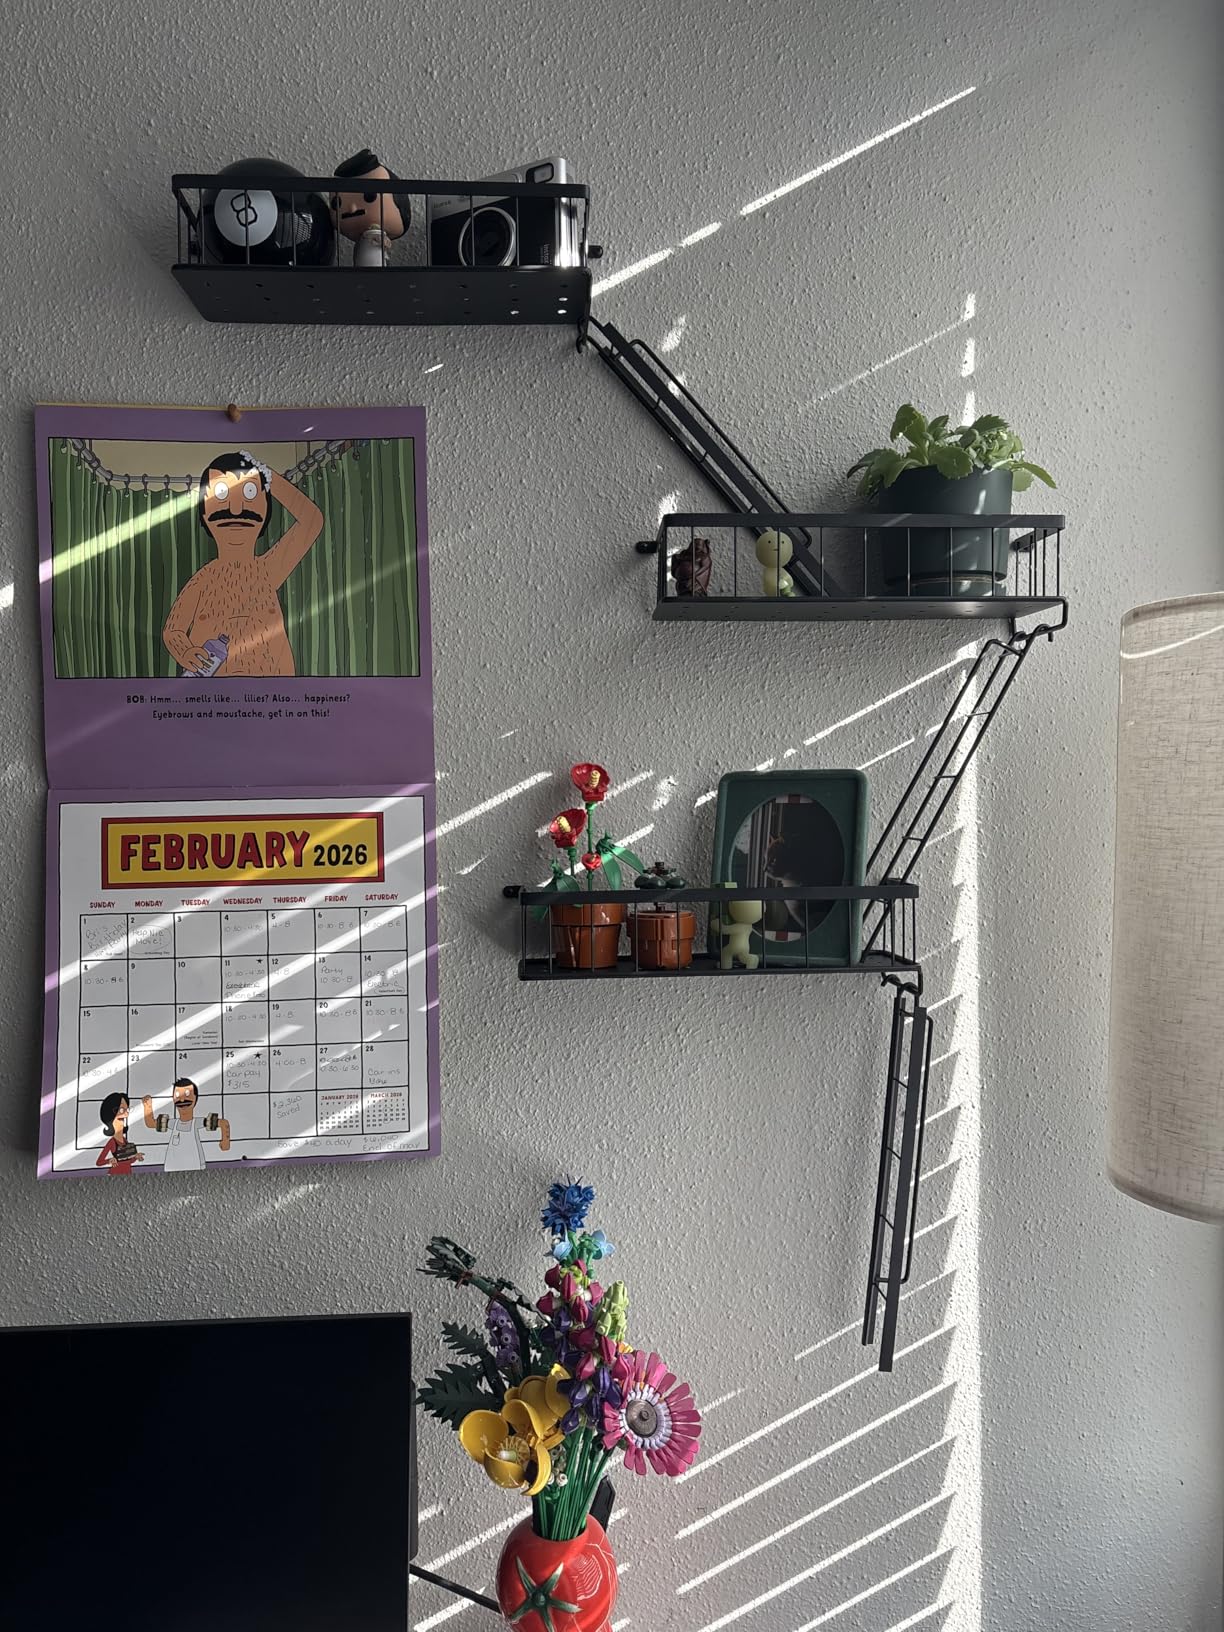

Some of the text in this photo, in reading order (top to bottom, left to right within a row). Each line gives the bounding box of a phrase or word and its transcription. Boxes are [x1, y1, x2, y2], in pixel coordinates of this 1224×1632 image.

[127, 693, 351, 705] BOB: Hmm... smells like... lilies? Also... happiness?
[152, 708, 330, 720] Eyebrows and moustache, get in on this!
[120, 830, 368, 872] FEBRUARY 2026
[89, 893, 399, 909] SUNDAY MONDAY TUESDAY WEDNESDAY THURSDAY FRIDAY SATURDAY
[177, 915, 182, 923] 3
[271, 912, 276, 920] 5
[318, 911, 323, 919] 6
[318, 956, 326, 964] 13
[364, 954, 372, 962] 14
[225, 959, 231, 967] 11
[225, 1005, 233, 1013] 18
[272, 1003, 280, 1011] 19
[319, 1001, 329, 1009] 20
[83, 1010, 91, 1018] 15
[131, 1008, 139, 1016] 16
[82, 1056, 91, 1064] 22
[130, 1054, 140, 1062] 23
[179, 1052, 188, 1060] 24
